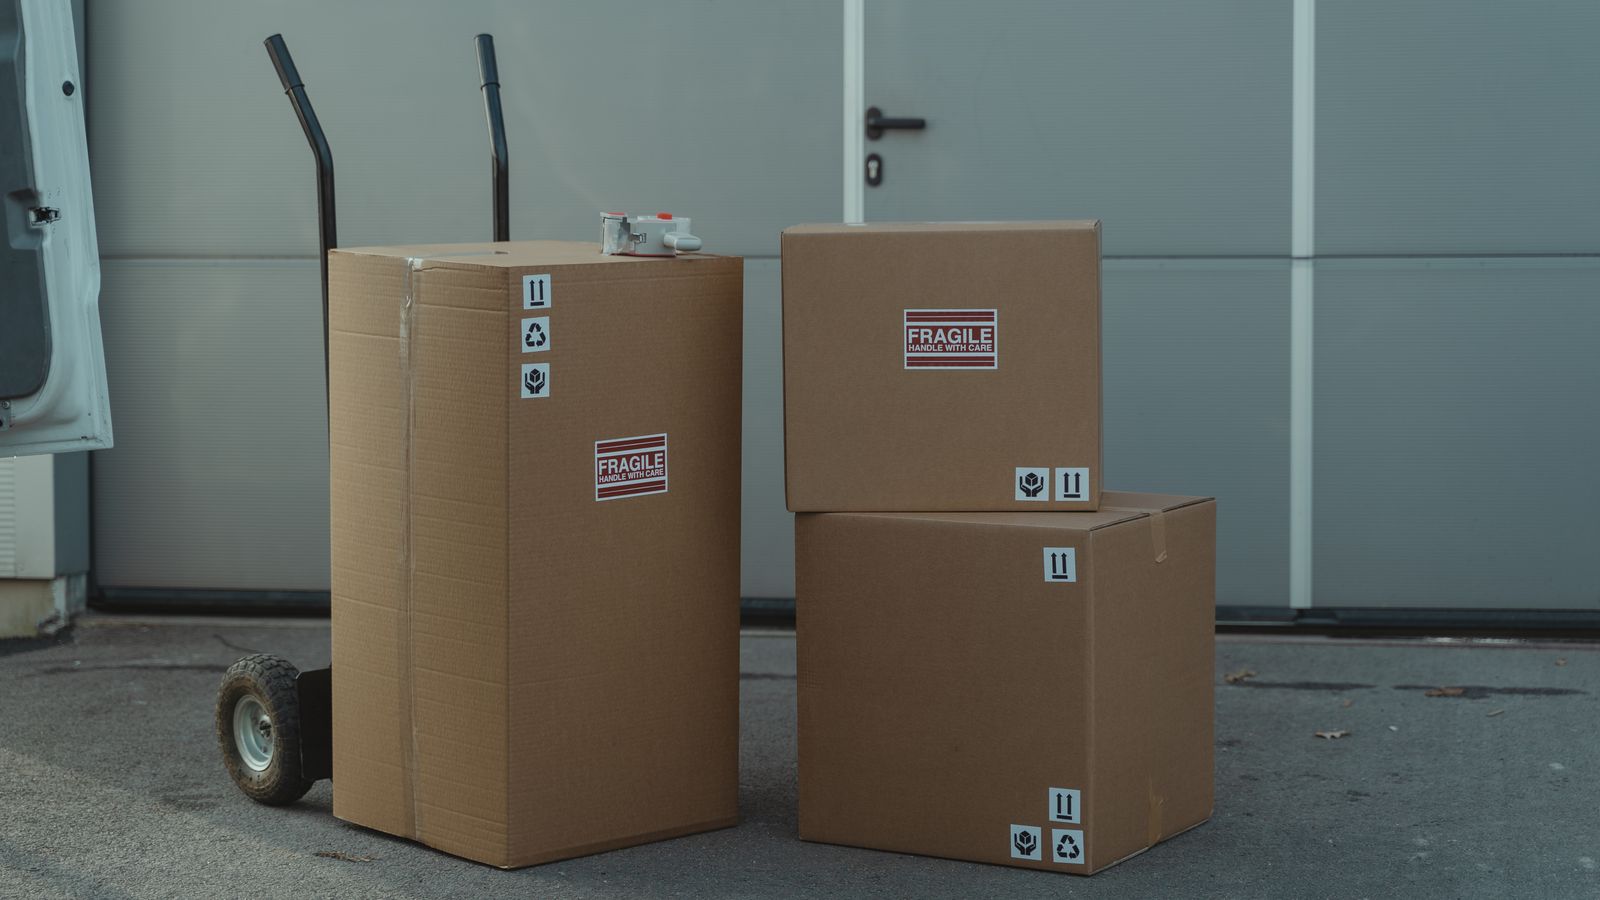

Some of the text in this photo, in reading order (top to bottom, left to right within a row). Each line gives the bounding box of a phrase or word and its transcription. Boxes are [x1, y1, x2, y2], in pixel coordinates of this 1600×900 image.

[908, 328, 992, 344] FRAGILE
[598, 453, 664, 475] FRAGILE
[599, 468, 664, 483] HANDLE WITH CARE
